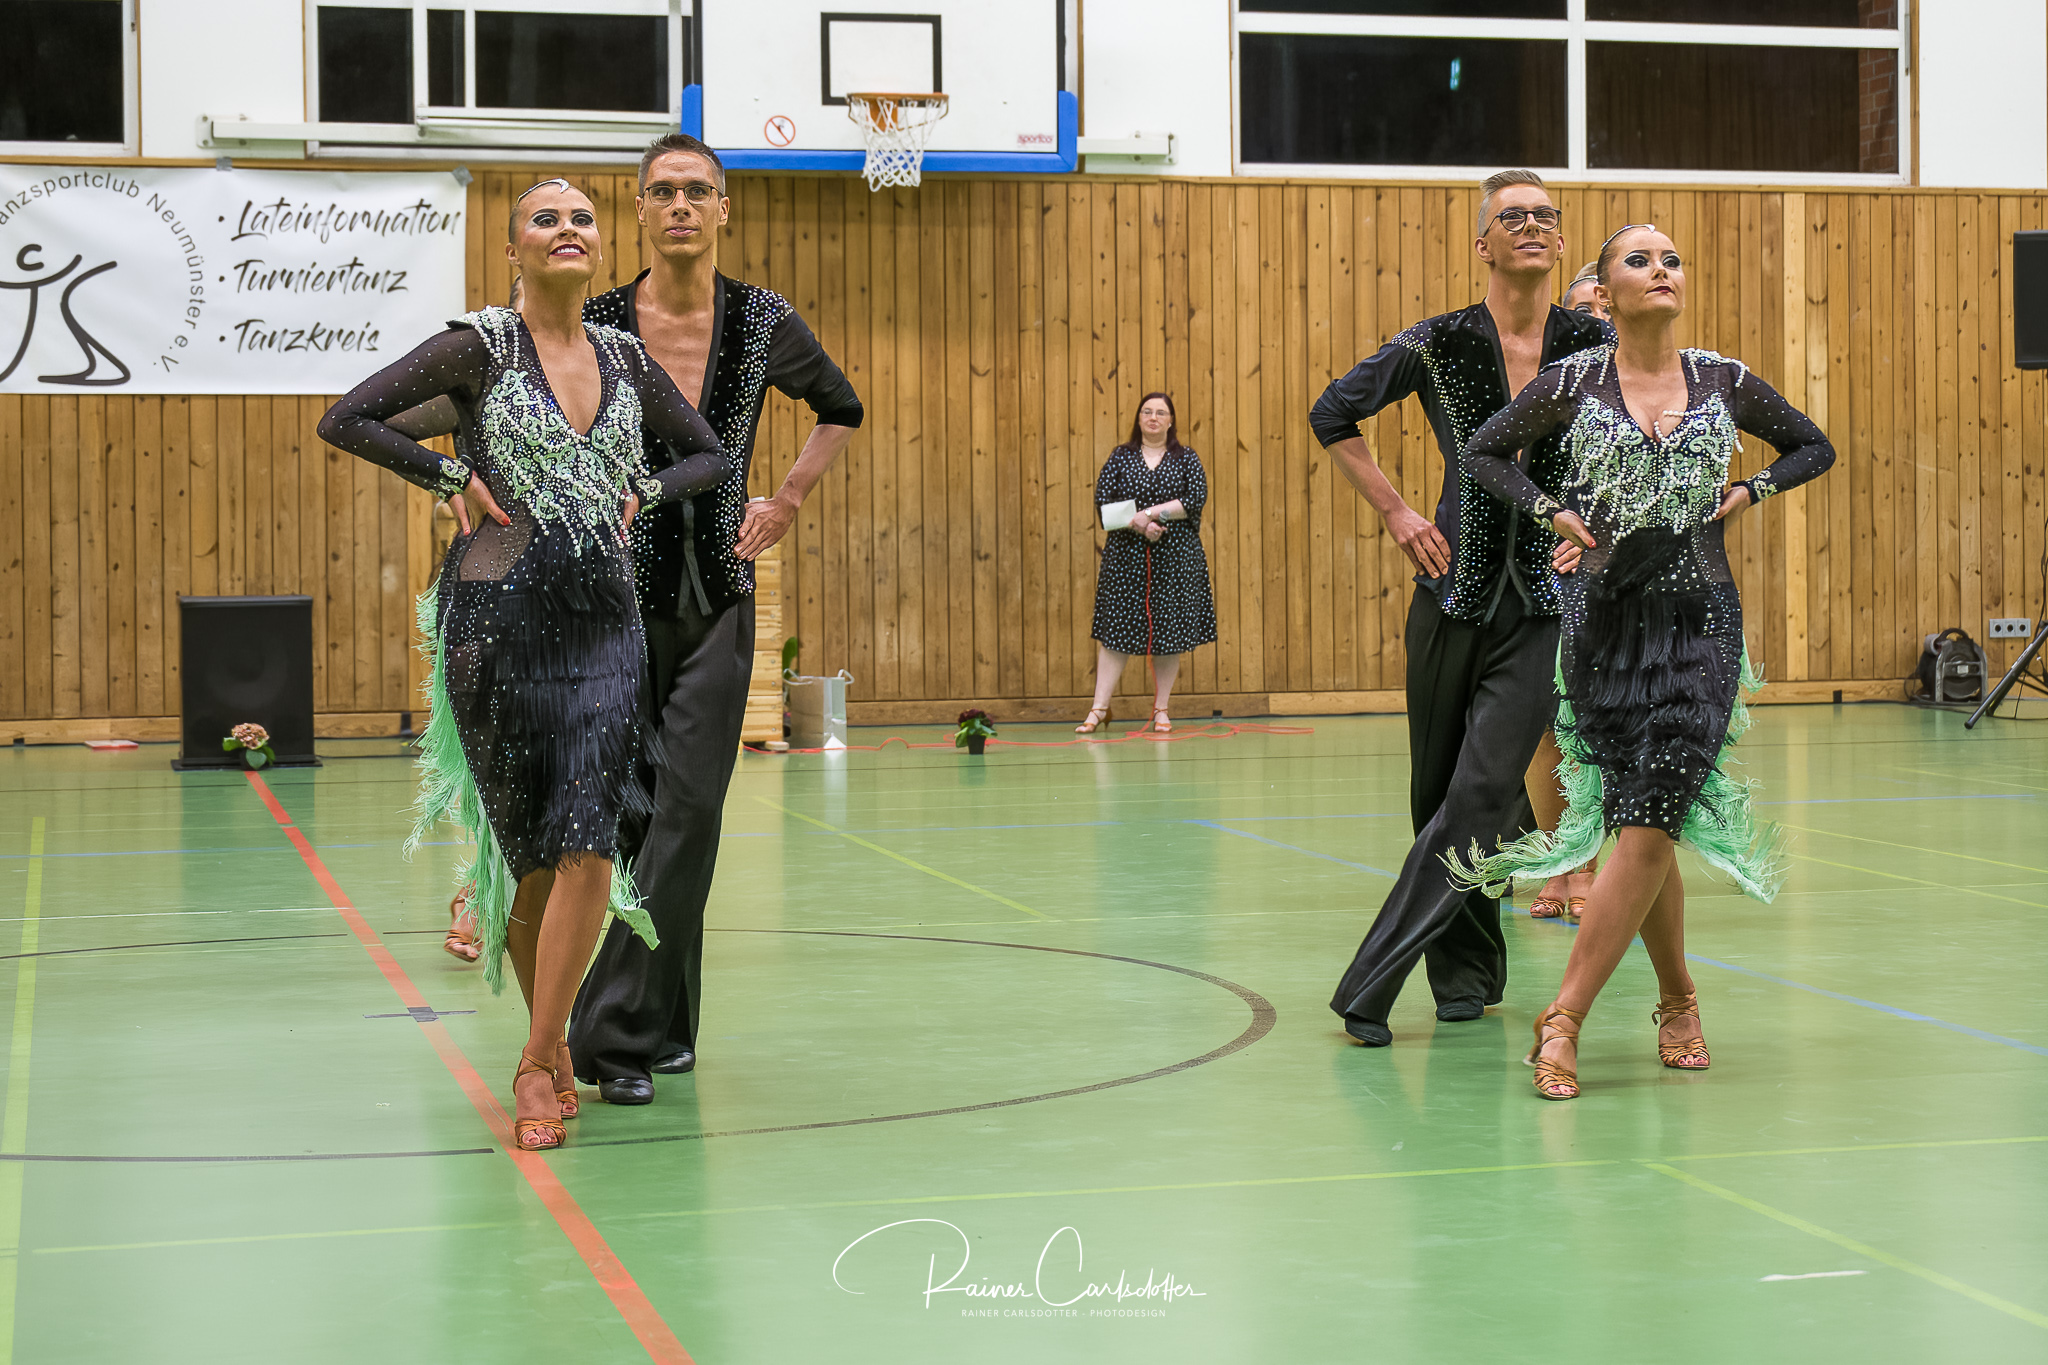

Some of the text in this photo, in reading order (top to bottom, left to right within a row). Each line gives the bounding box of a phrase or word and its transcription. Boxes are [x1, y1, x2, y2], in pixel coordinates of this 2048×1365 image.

[231, 197, 462, 244] Lateinformation
[146, 193, 207, 330] Neumünster
[233, 256, 409, 294] Turniertanz
[234, 319, 380, 353] Tanzkreis
